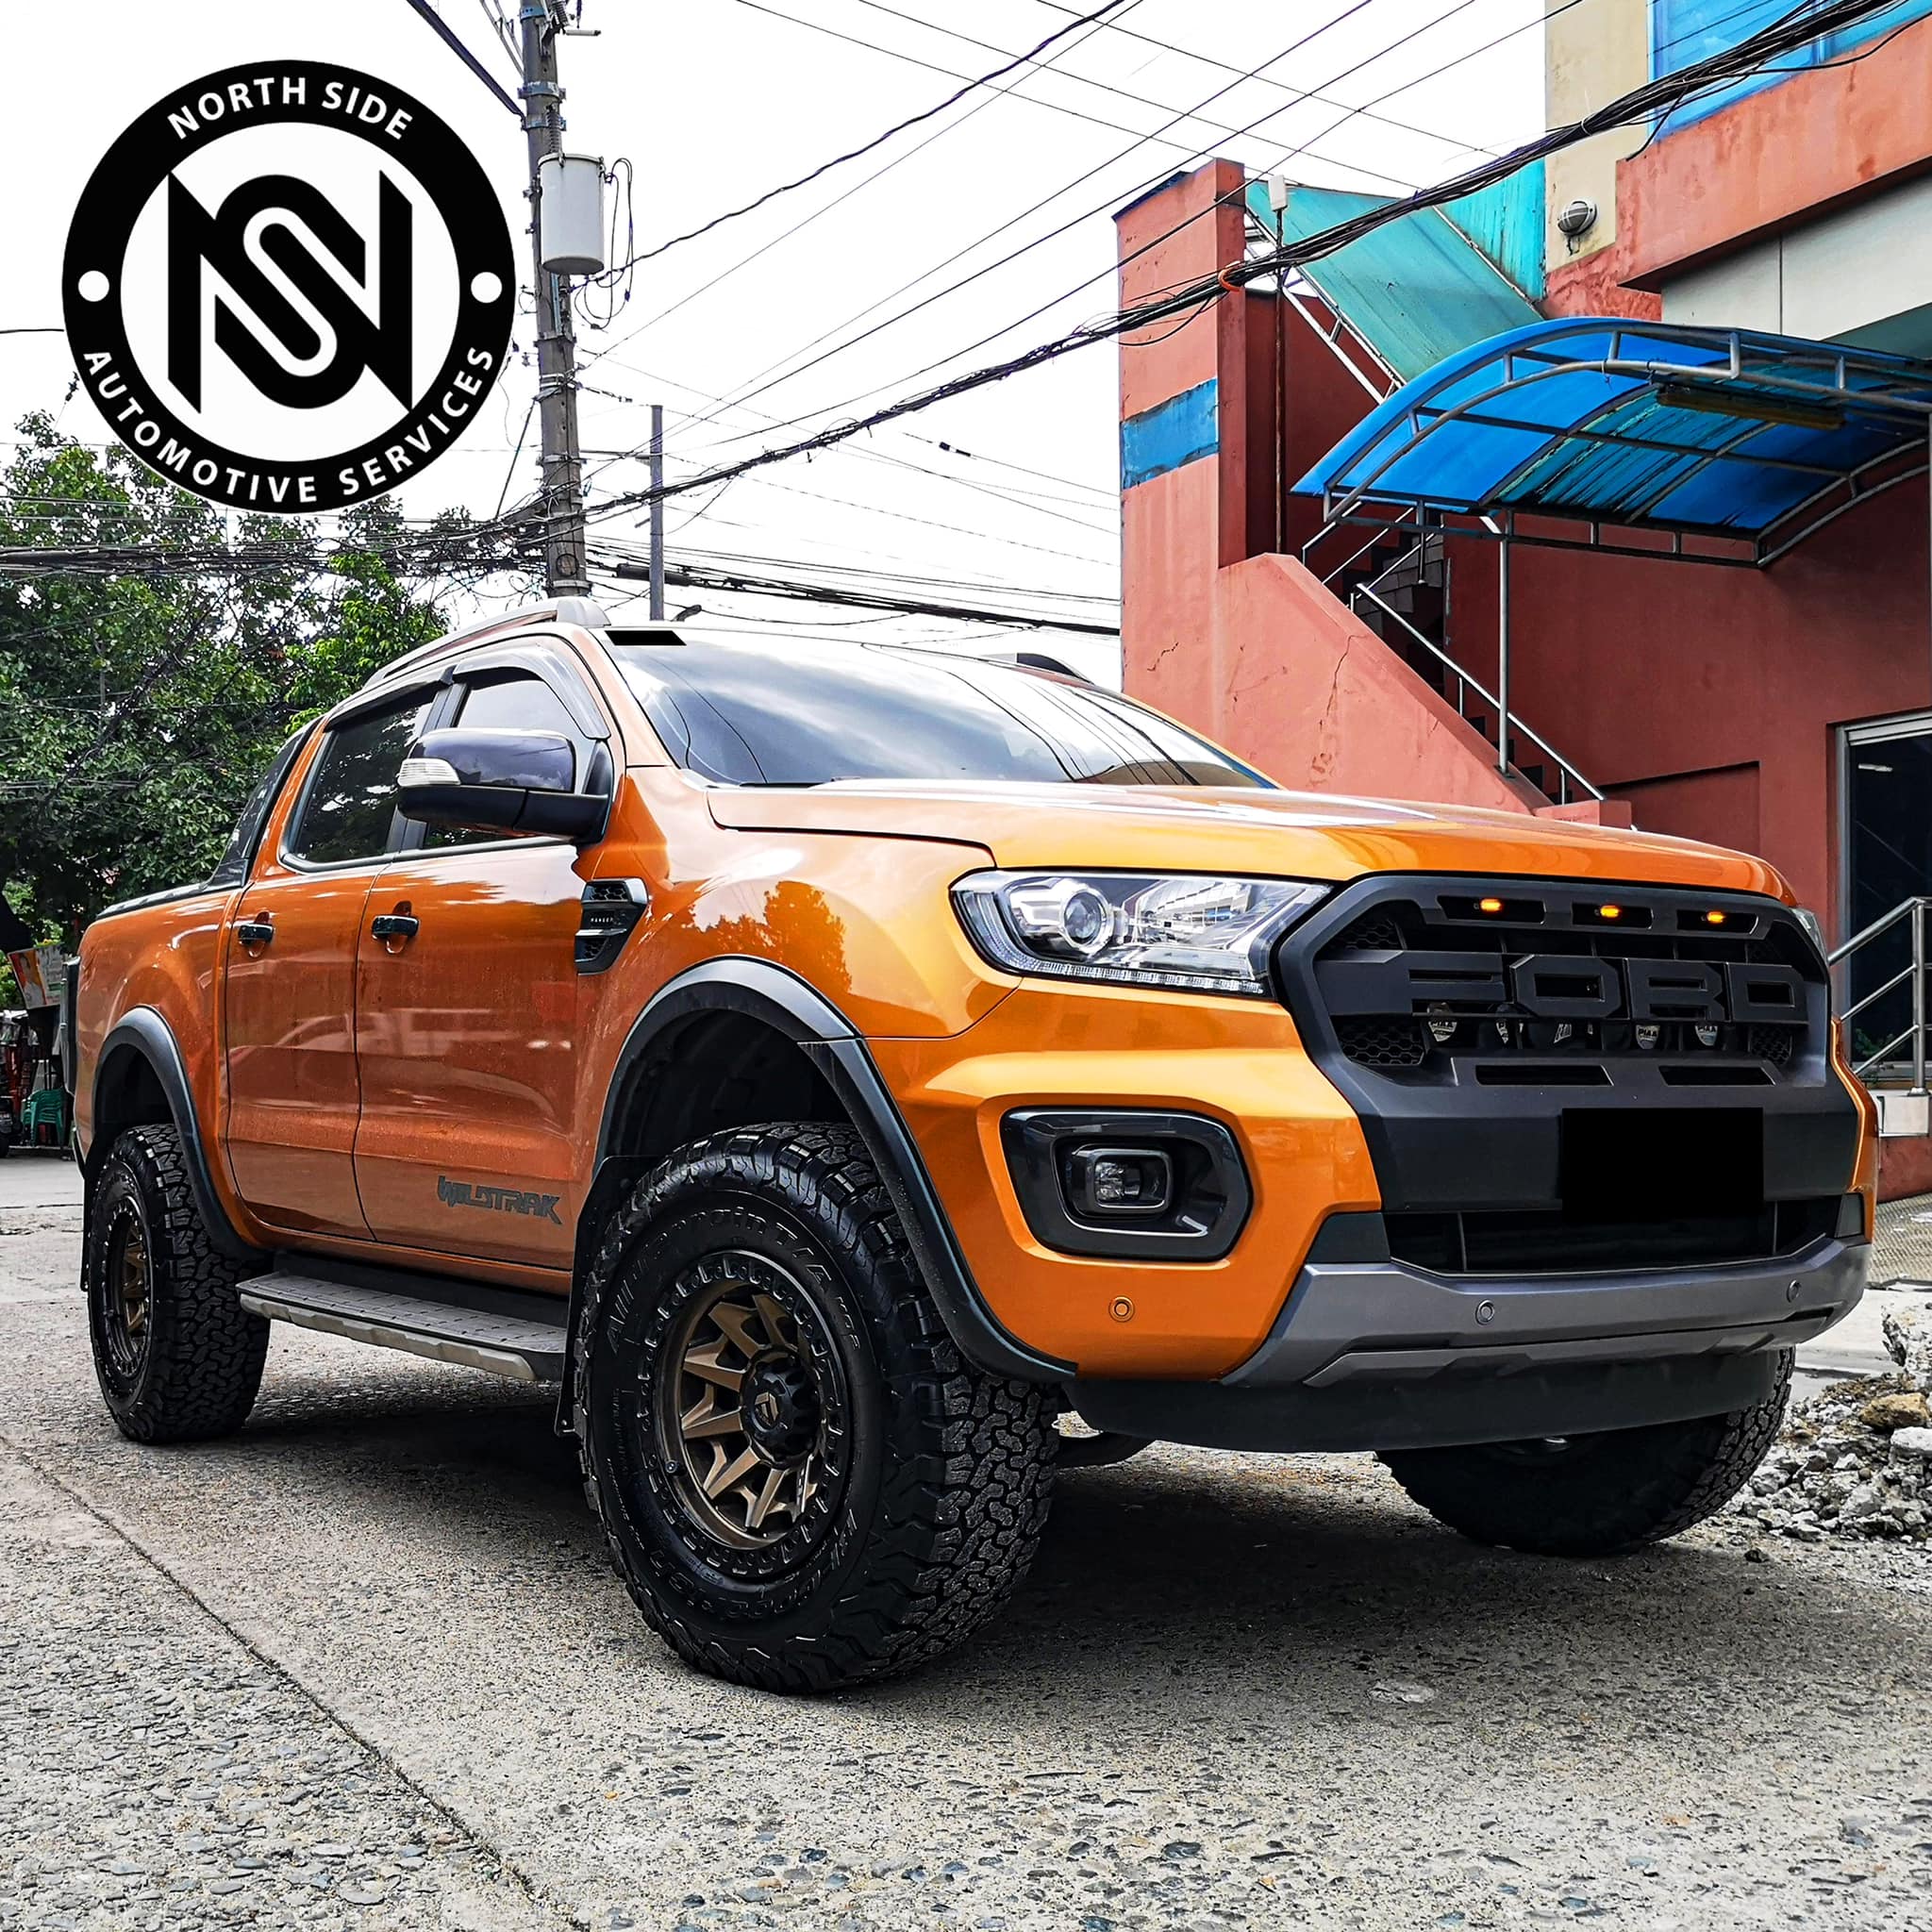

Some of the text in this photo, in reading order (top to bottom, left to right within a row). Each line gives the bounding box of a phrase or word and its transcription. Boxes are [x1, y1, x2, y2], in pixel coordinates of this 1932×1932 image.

[1379, 951, 1810, 1024] FORD
[1637, 1027, 1658, 1038] PIAA
[437, 1175, 563, 1225] WILDTRAK
